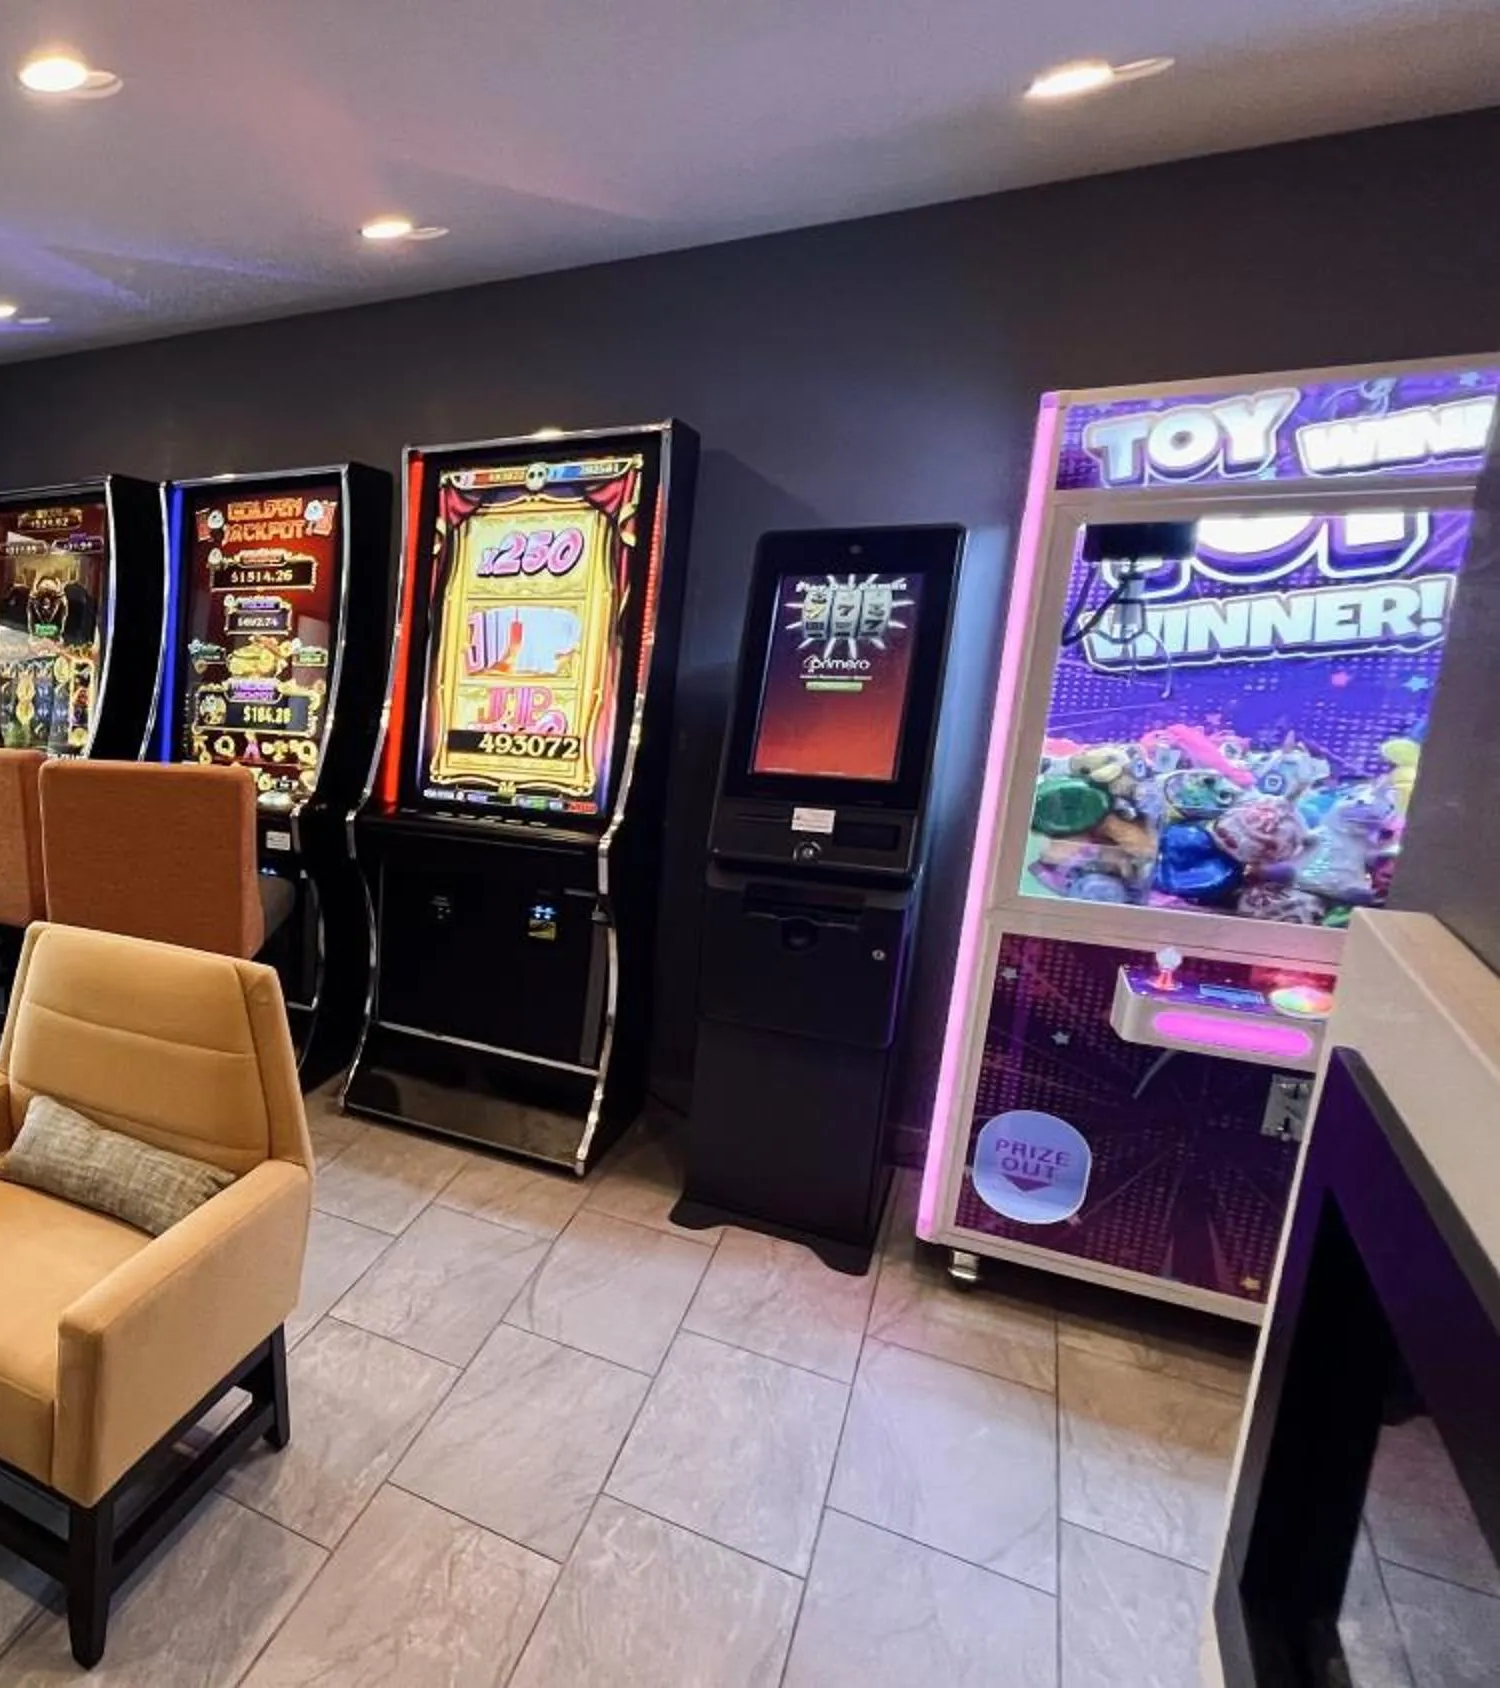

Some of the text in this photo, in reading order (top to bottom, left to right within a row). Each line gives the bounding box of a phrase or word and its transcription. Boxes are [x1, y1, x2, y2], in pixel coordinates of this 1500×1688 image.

[1086, 392, 1296, 486] TOY
[222, 520, 306, 546] JACKPOT
[1086, 578, 1451, 664] WINNER!
[479, 733, 580, 759] 493072
[996, 1139, 1071, 1167] PRIZE
[1002, 1157, 1055, 1179] OUT
